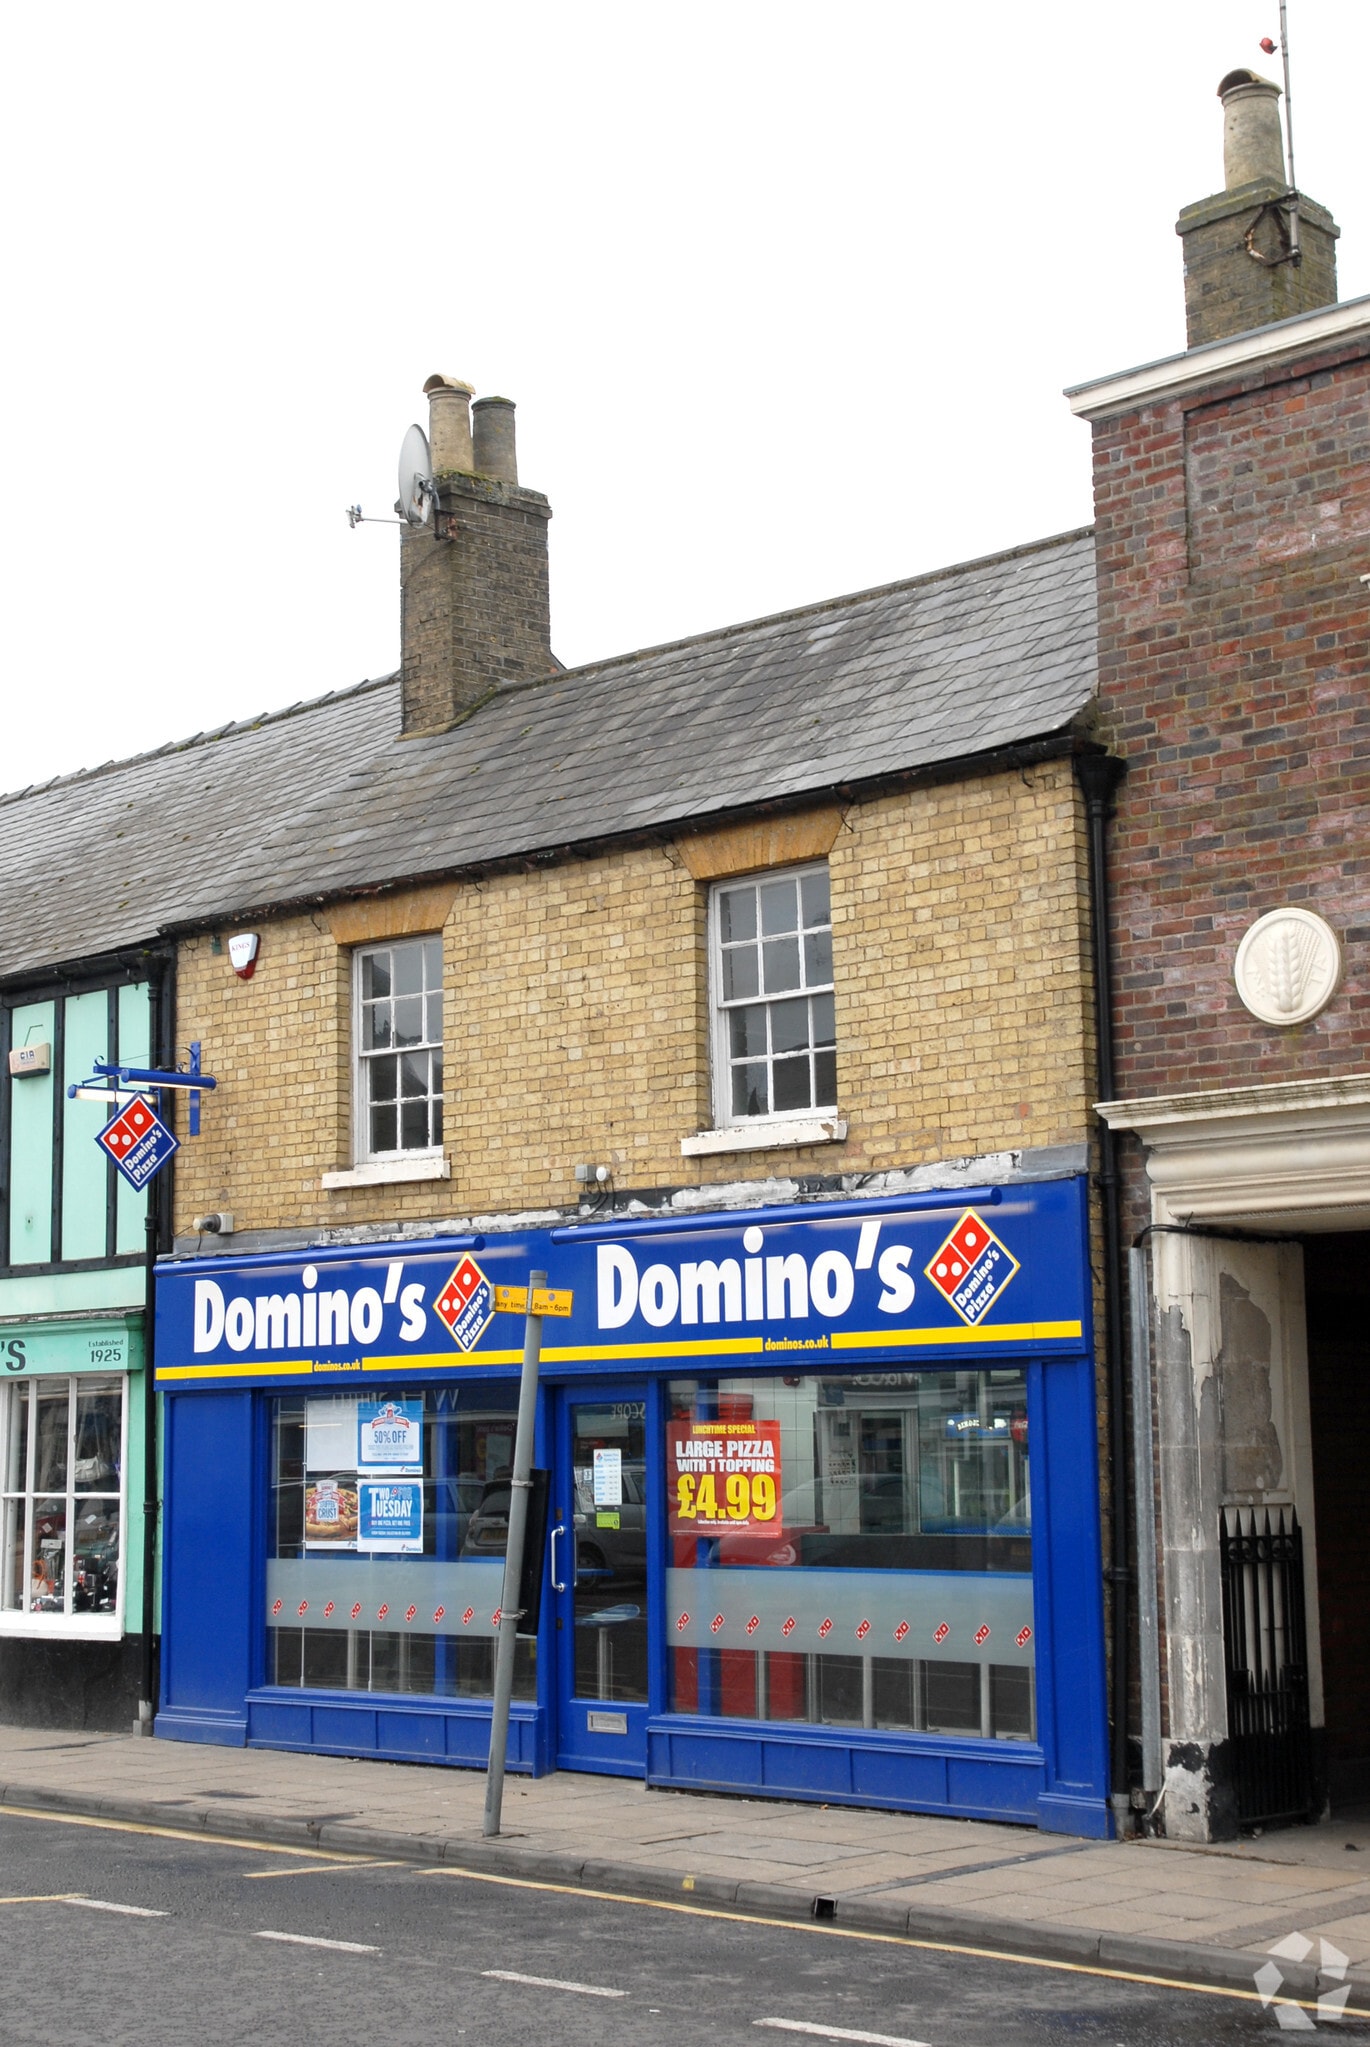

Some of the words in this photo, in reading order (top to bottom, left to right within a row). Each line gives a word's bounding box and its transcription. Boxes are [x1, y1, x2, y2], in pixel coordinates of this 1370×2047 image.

[124, 1129, 162, 1170] Domino's
[597, 1221, 916, 1330] Domino's
[955, 1249, 1000, 1308] Domino's
[193, 1262, 426, 1354] Domino's
[454, 1287, 488, 1337] Domino's
[534, 1302, 548, 1310] 8am
[554, 1304, 569, 1312] 6pm
[88, 1339, 124, 1348] Established
[765, 1334, 829, 1352] dominos.co.uk
[90, 1348, 122, 1363] 1925
[314, 1358, 361, 1372] dominos.co.uk
[374, 1430, 391, 1444] 50%
[392, 1430, 407, 1443] OFF
[692, 1424, 727, 1434] LUNCHTIME
[727, 1424, 756, 1434] SPECIAL
[675, 1440, 723, 1458] LARGE
[726, 1440, 774, 1458] PIZZA
[677, 1459, 707, 1472] WITH
[709, 1459, 716, 1472] 1
[718, 1459, 775, 1472] TOPPING
[677, 1473, 776, 1521] £4.99
